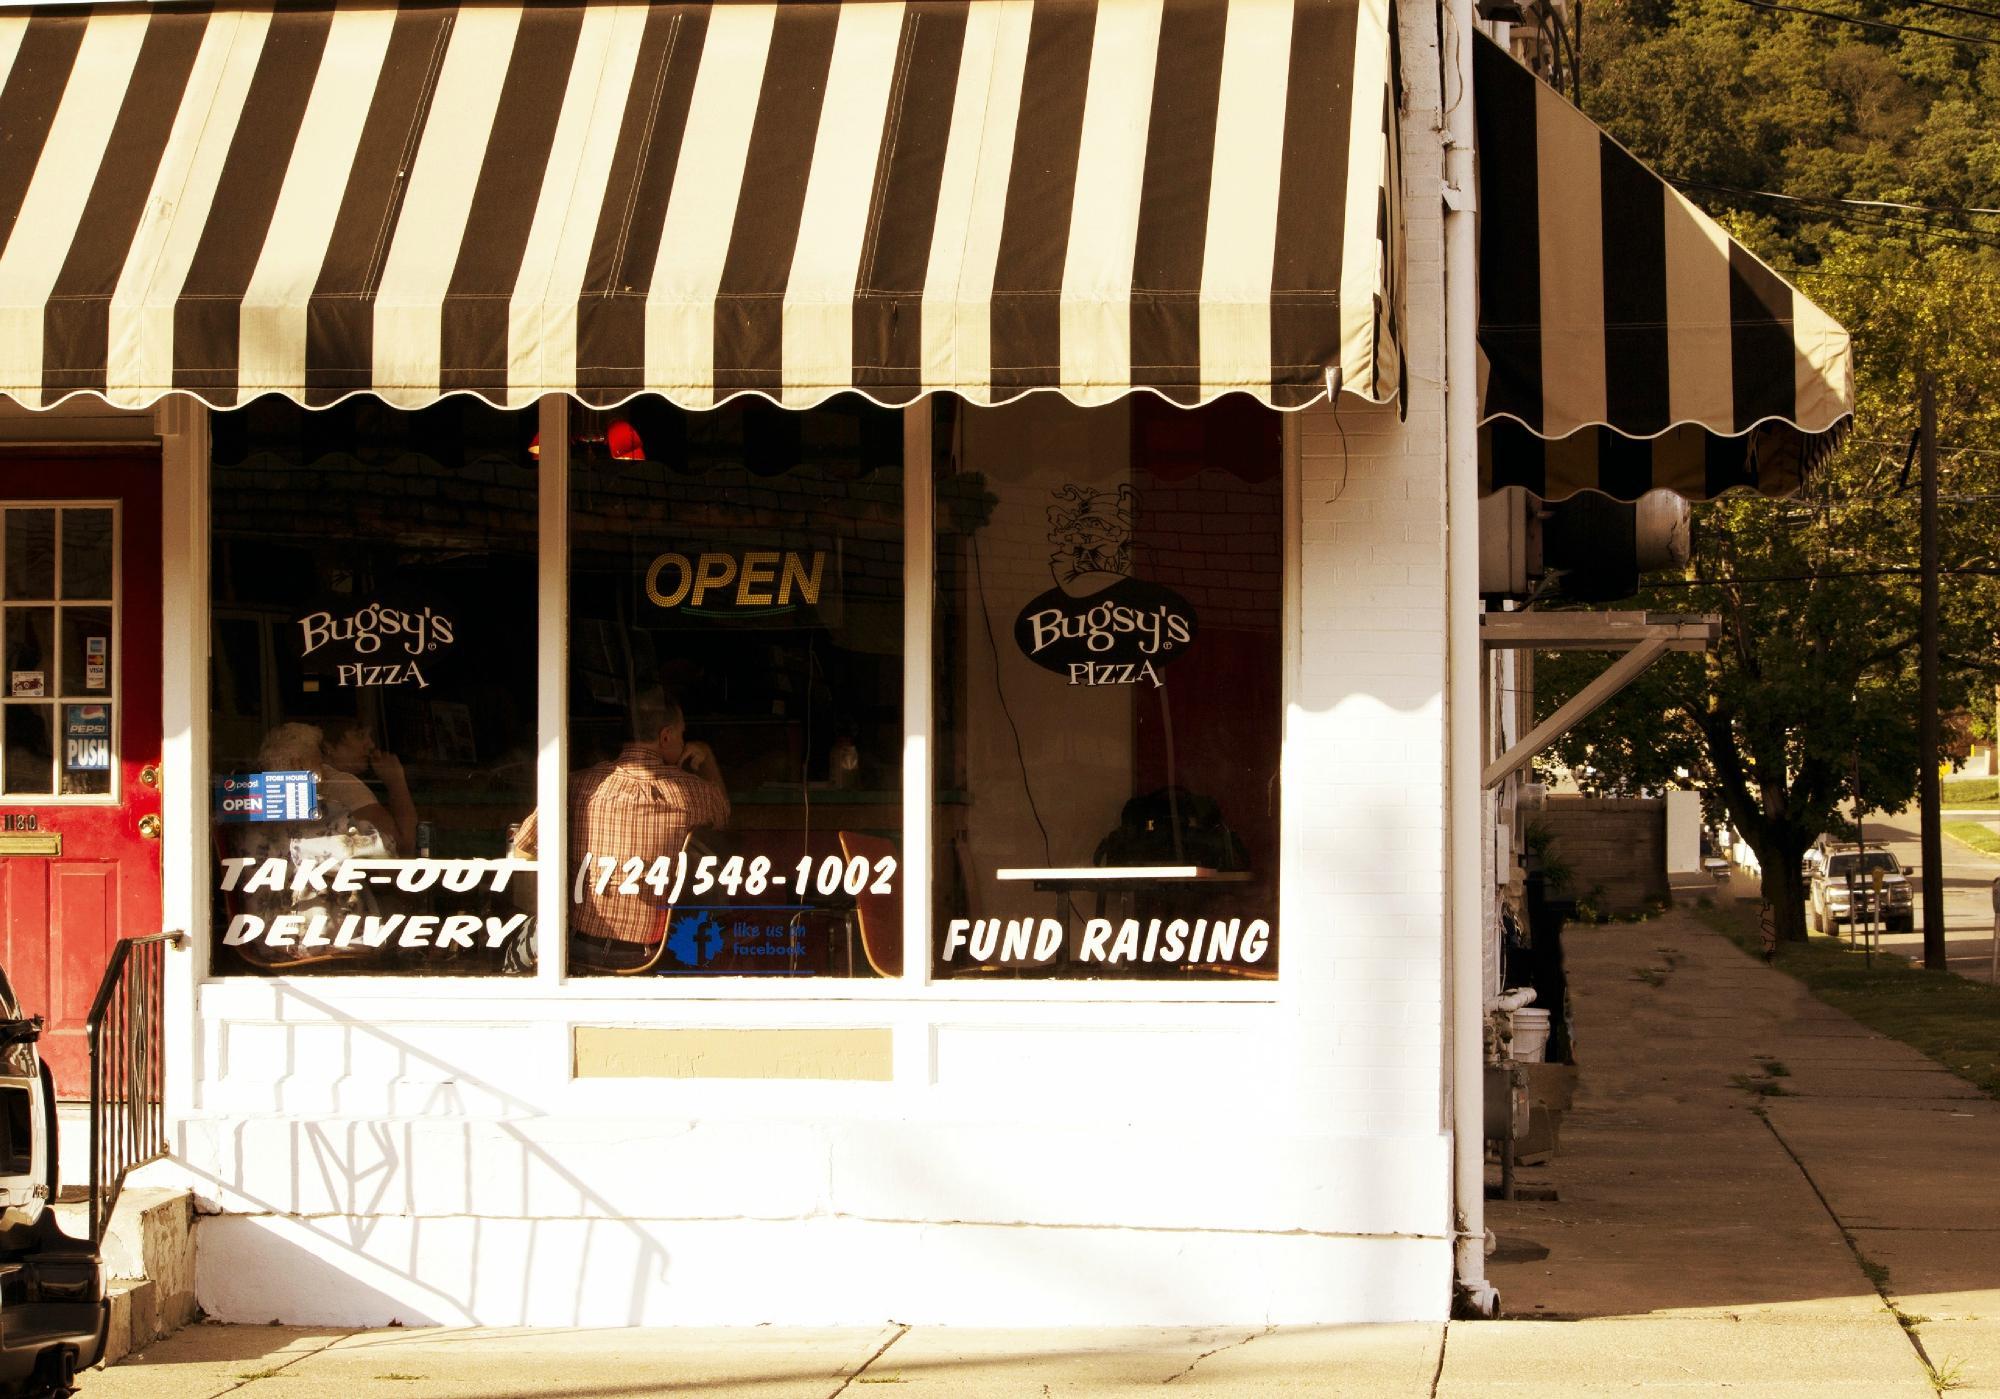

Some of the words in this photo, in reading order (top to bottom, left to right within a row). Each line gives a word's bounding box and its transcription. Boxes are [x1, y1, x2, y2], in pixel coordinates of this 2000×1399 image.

[646, 551, 825, 607] OPEN
[297, 603, 454, 657] Bugsy's
[1026, 600, 1191, 654] Bugsy's
[337, 660, 430, 688] PIZZA
[1067, 659, 1164, 688] PIZZA
[70, 725, 105, 733] PEPSI
[68, 739, 109, 766] PUSH
[223, 798, 262, 811] OPEN
[219, 857, 527, 893] TAKE-OUT
[574, 851, 897, 904] (724)548-1002
[222, 913, 528, 948] DELIVERY
[733, 922, 760, 938] like
[766, 926, 784, 938] us
[942, 917, 1063, 962] FUND
[1079, 918, 1271, 963] RAISING
[733, 943, 806, 956] facebook
